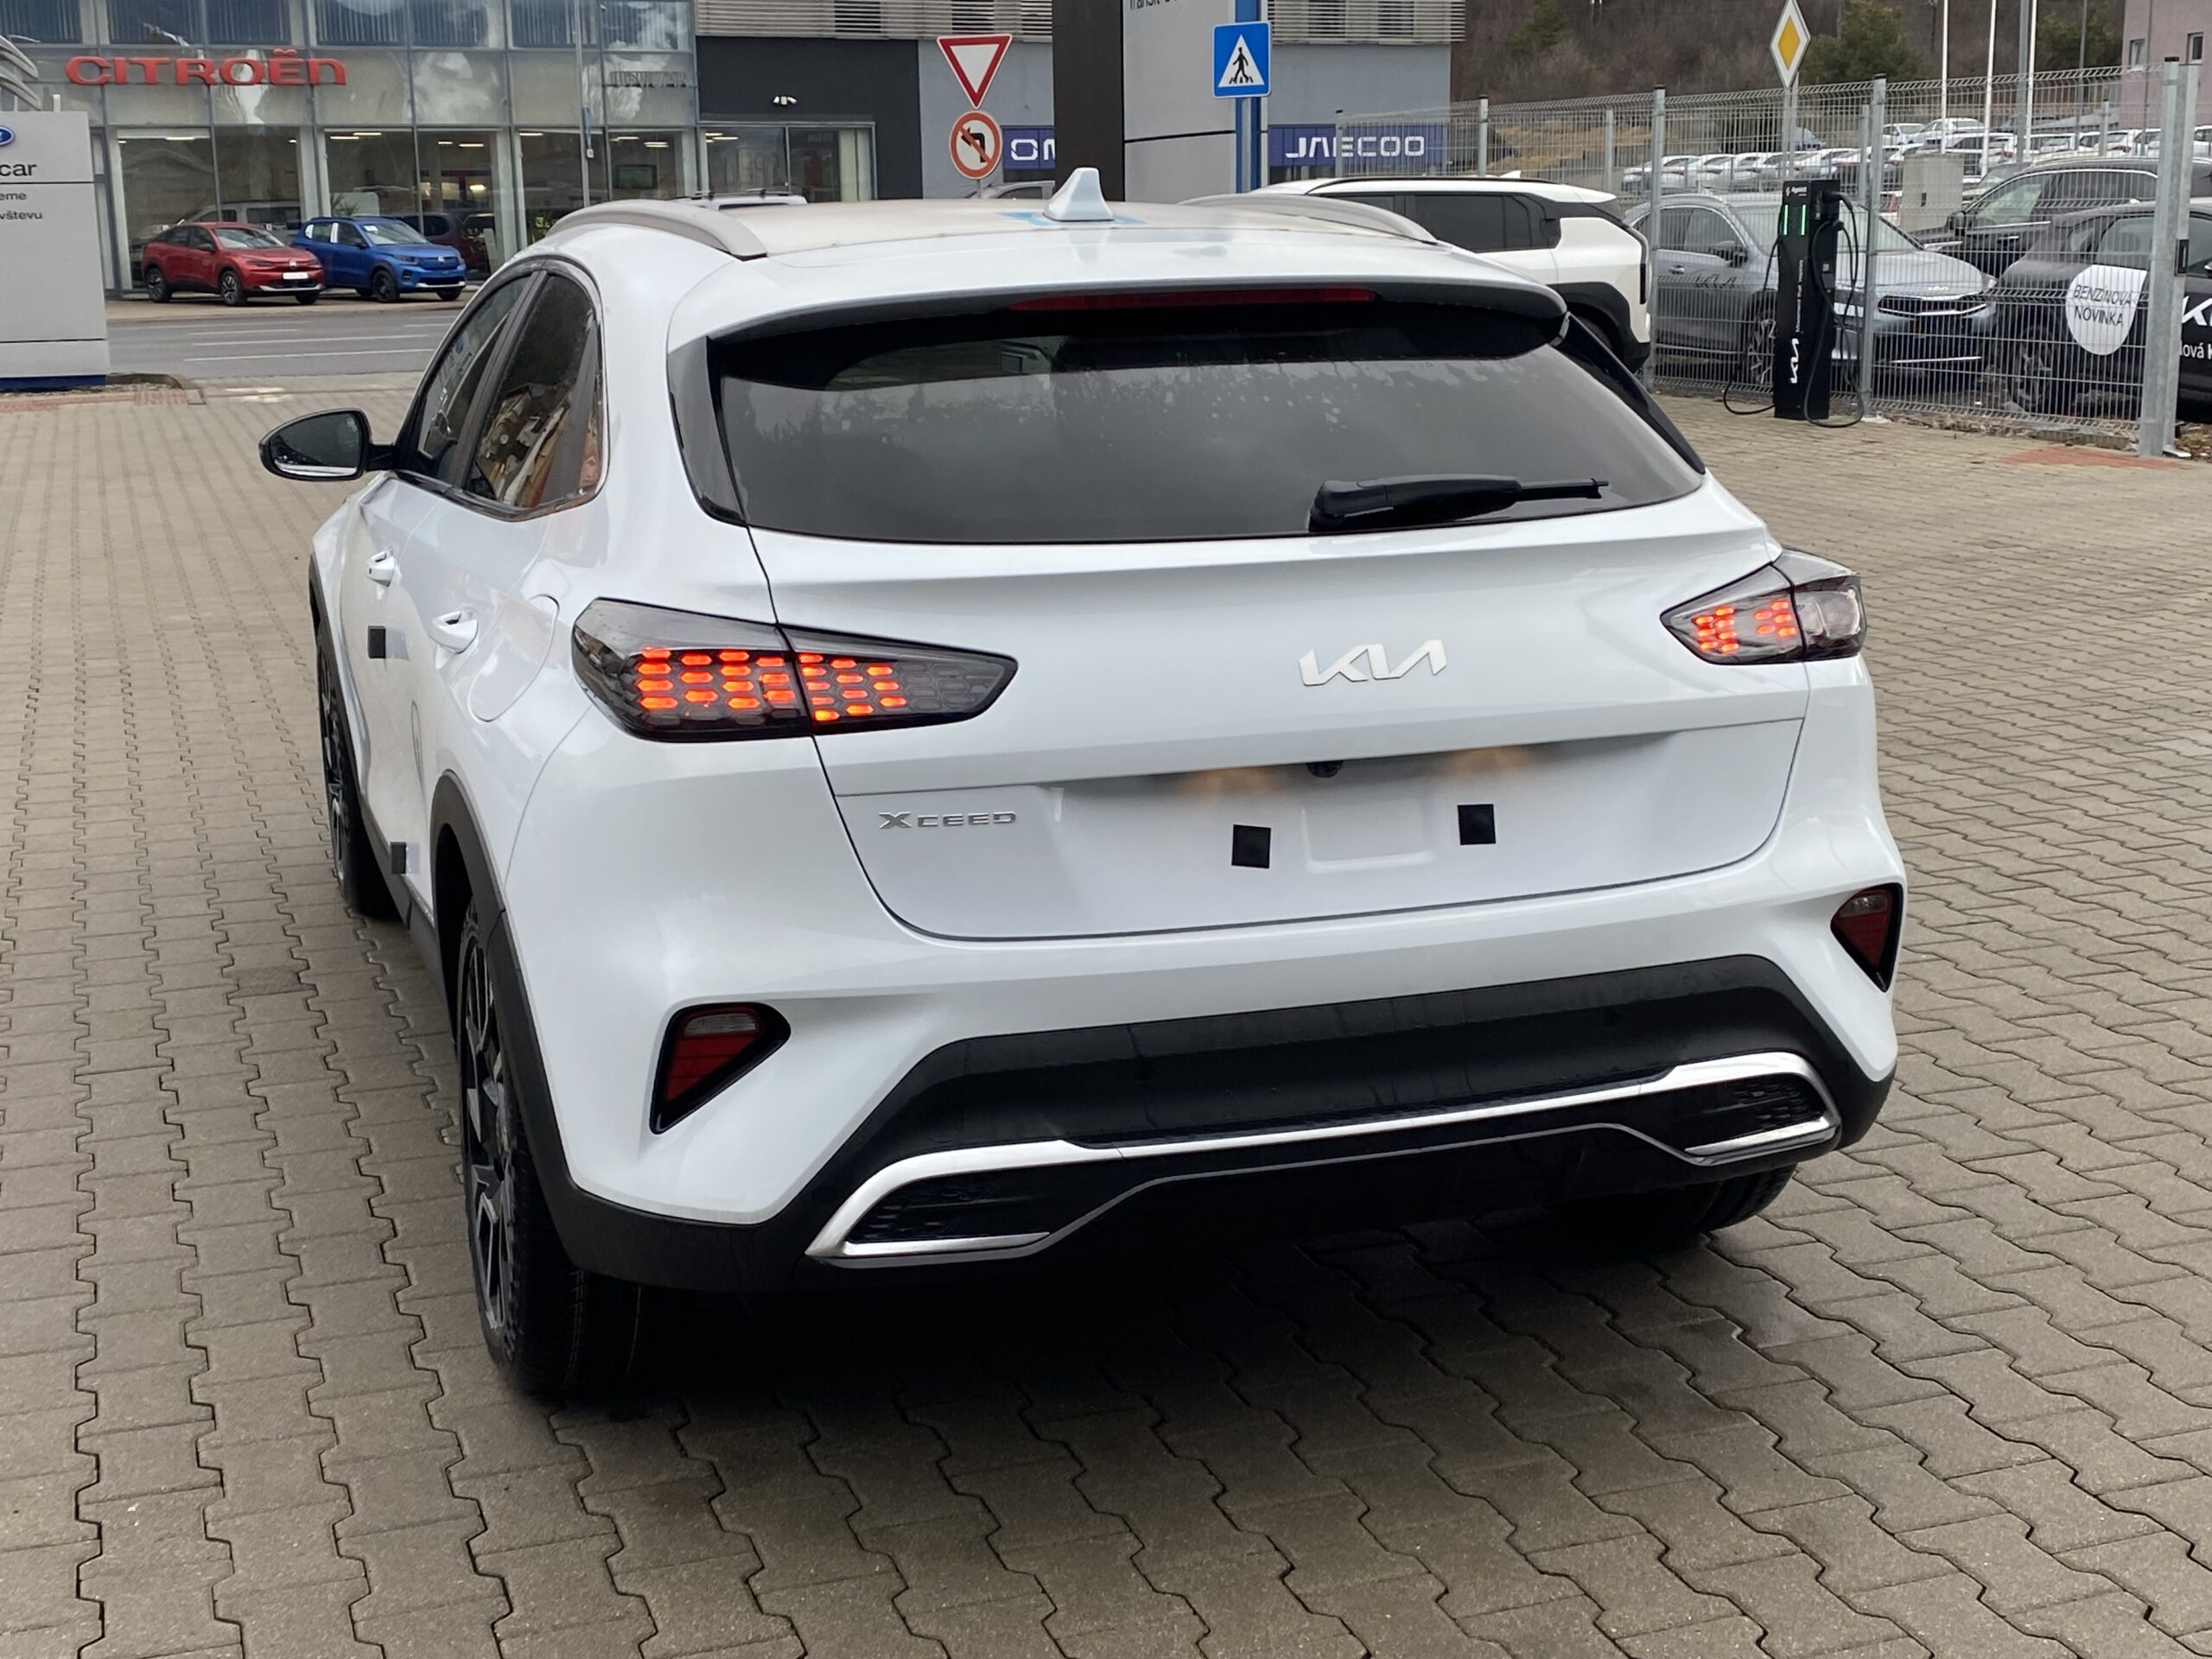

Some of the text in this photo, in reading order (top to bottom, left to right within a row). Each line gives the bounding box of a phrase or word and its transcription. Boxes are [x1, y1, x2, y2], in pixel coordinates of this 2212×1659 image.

[1285, 136, 1425, 158] JAECOO
[2075, 305, 2124, 327] NOVINKA
[2180, 342, 2204, 359] ová
[1299, 639, 1447, 687] KIA
[879, 810, 1016, 830] XCEED
